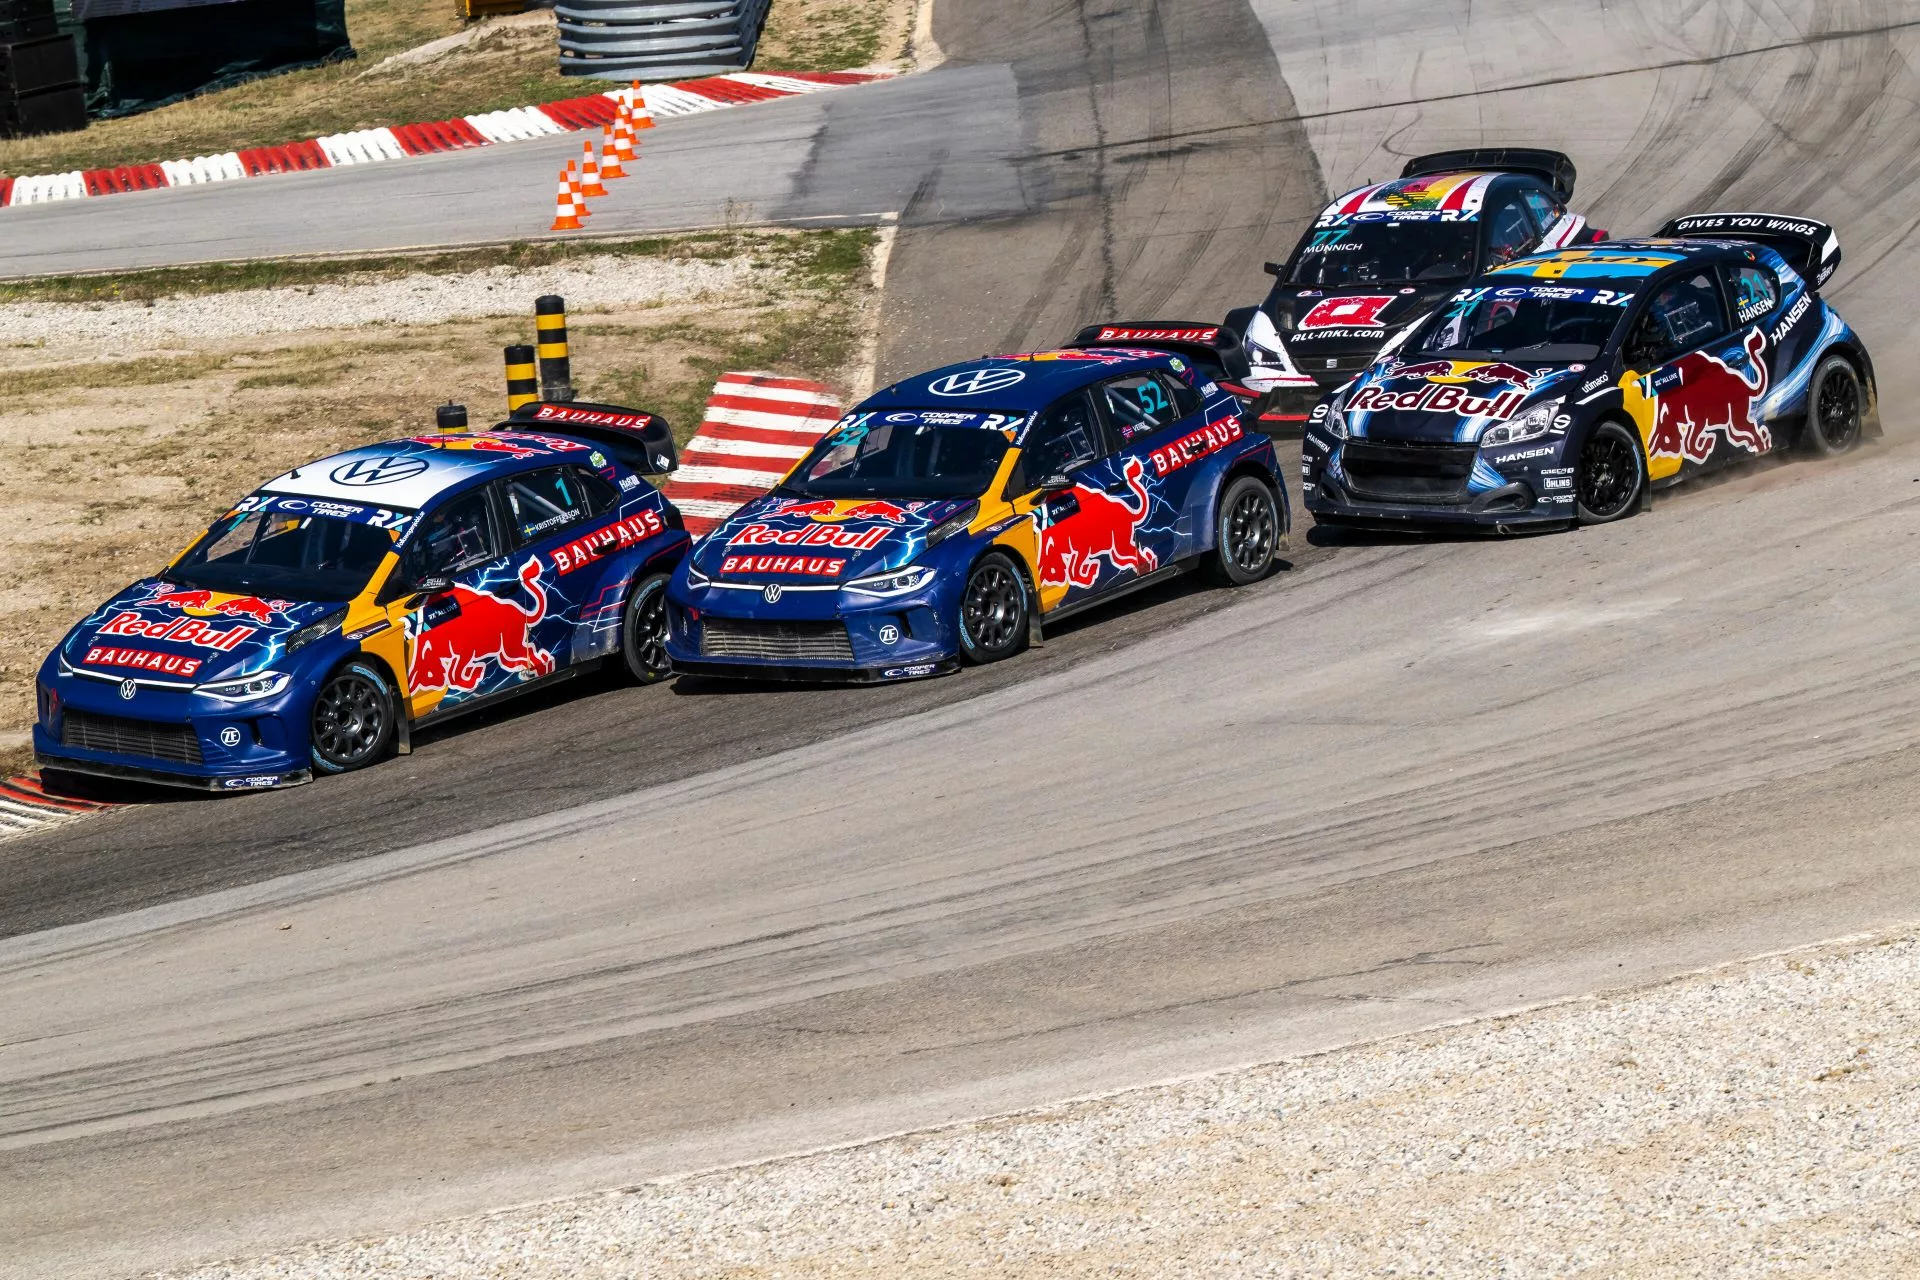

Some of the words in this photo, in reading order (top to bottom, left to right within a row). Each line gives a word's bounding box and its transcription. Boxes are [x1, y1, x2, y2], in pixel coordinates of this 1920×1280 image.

[1678, 217, 1725, 230] GIVES
[1730, 217, 1763, 227] YOU
[1766, 219, 1817, 236] WINGS
[1311, 229, 1350, 247] 77
[1303, 243, 1363, 254] MÜNNICH
[1529, 286, 1584, 295] COOPER
[1741, 271, 1768, 304] 21
[1443, 300, 1480, 317] 21
[1738, 298, 1774, 324] HANSEN
[1769, 291, 1812, 346] HANSEN
[1100, 328, 1218, 340] BAUHAUS
[1582, 374, 1609, 394] utimaco
[1136, 381, 1169, 414] 52
[1344, 384, 1440, 412] Red
[1422, 384, 1527, 421] Bull
[537, 407, 651, 429] BAUHAUS
[919, 412, 976, 421] COOPER
[923, 417, 964, 425] TIRES
[831, 427, 870, 446] 52
[1153, 415, 1242, 473] BAUHAUS
[1307, 432, 1331, 453] HANSEN
[1495, 447, 1554, 463] HANSEN
[555, 477, 572, 506] 1
[1546, 477, 1571, 488] ÖHLINS
[310, 501, 364, 514] COOPER
[312, 508, 351, 518] TIRES
[535, 508, 580, 531] KRISTOFFERSSON
[554, 510, 663, 571] BAUHAUS
[726, 523, 813, 546] Red
[800, 524, 895, 550] Bull
[723, 557, 846, 574] BAUHAUS
[96, 611, 188, 641] Red
[166, 620, 258, 652] Bull
[880, 626, 898, 644] ZF
[86, 649, 201, 674] BAUHAUS
[904, 664, 935, 672] COOPER
[222, 728, 240, 745] ZF
[245, 775, 278, 783] COOPER
